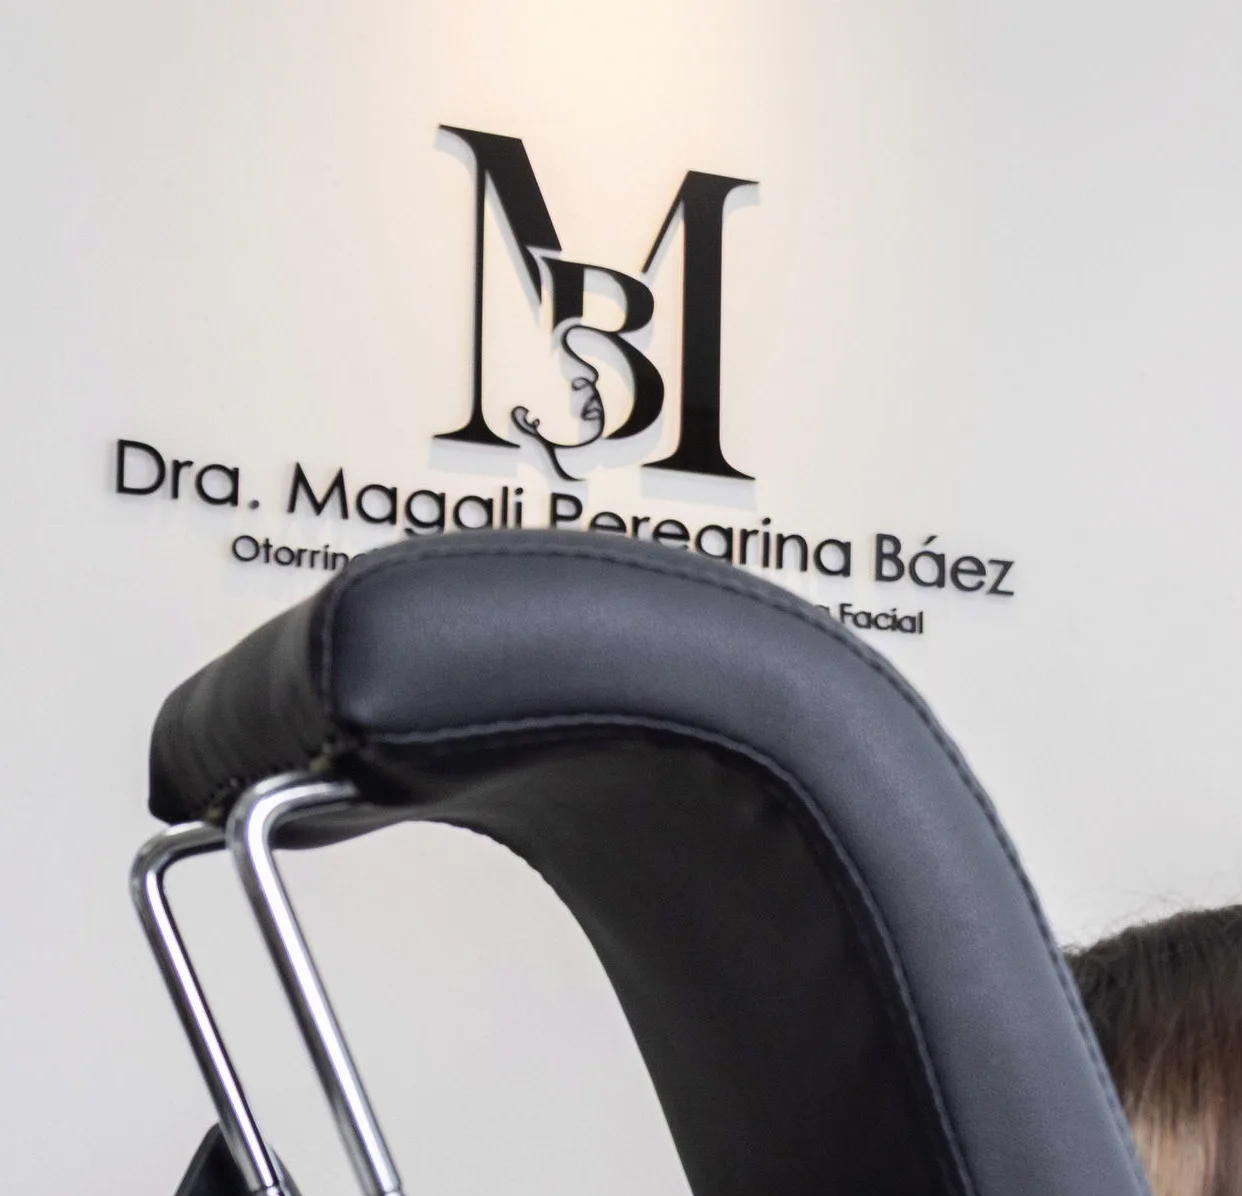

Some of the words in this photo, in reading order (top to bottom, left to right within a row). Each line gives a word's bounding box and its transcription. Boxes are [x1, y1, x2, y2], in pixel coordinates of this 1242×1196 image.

[116, 438, 260, 510] Dra.
[286, 461, 524, 537] Magali
[549, 491, 852, 579] Peregrina
[874, 533, 1015, 597] Báez
[231, 534, 367, 571] Otorrin
[839, 602, 925, 635] Facial
